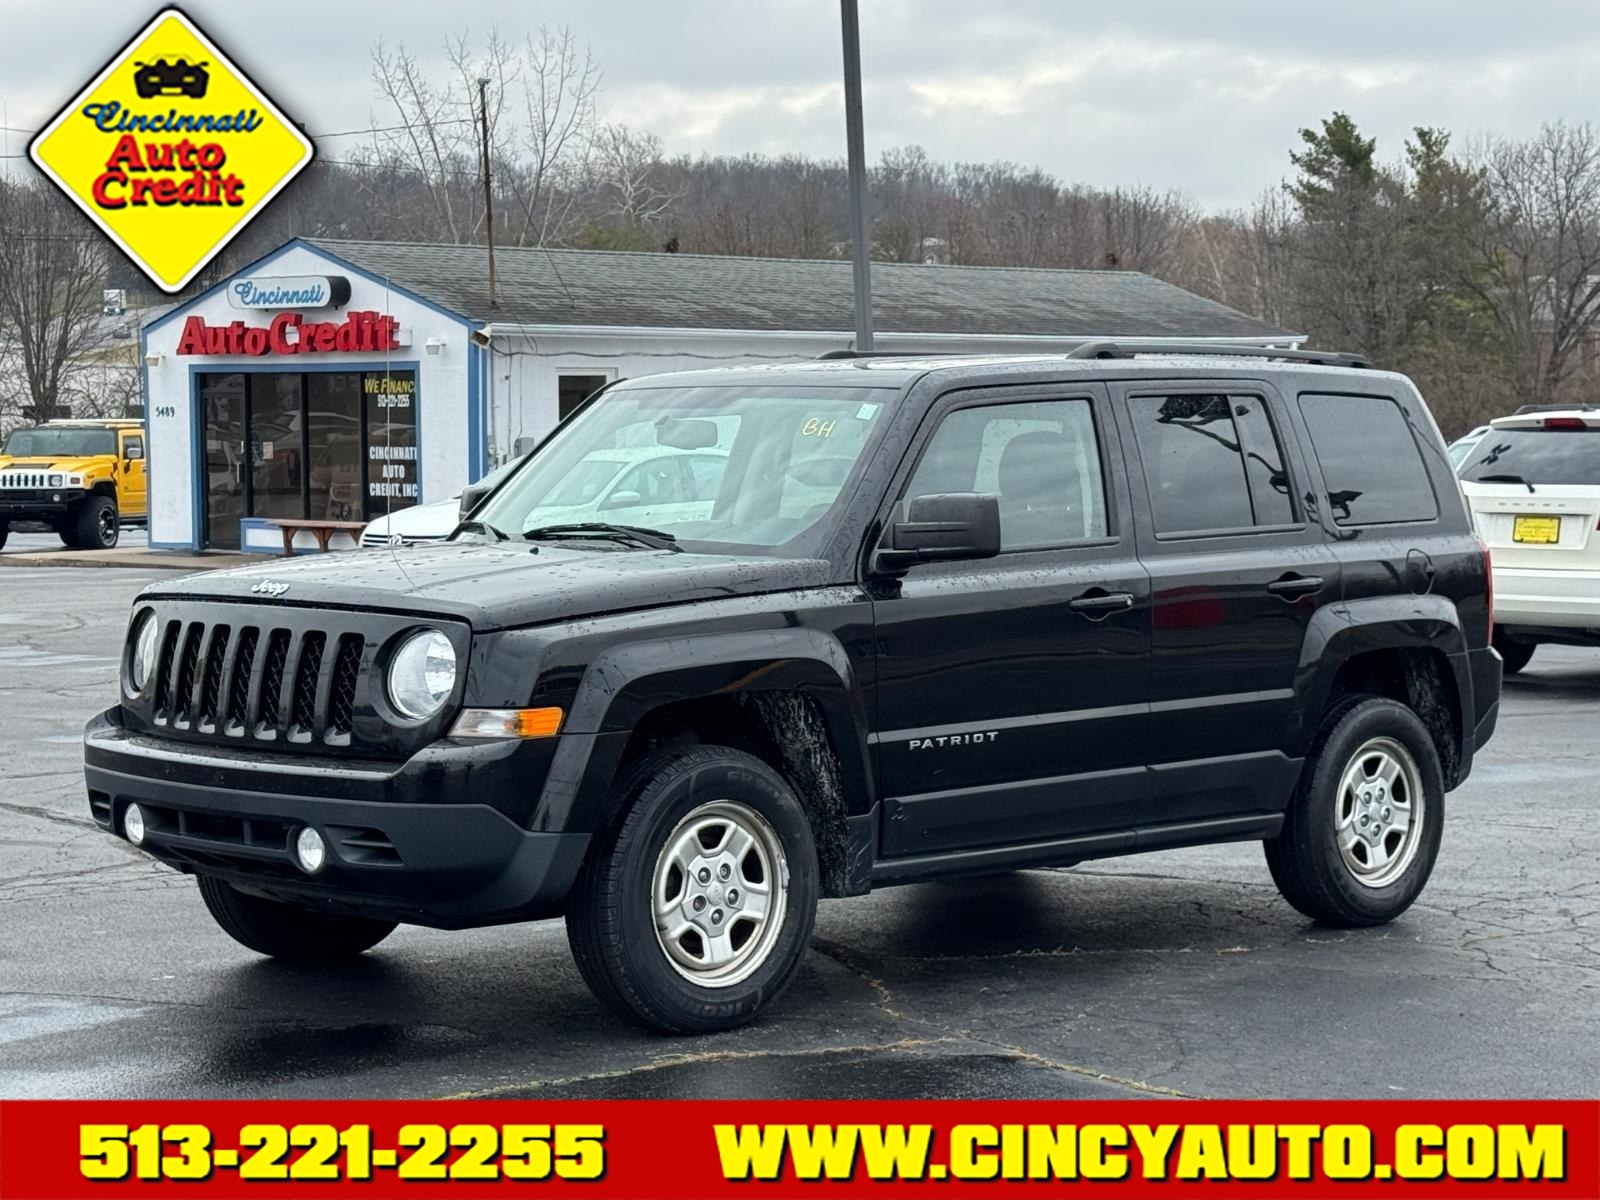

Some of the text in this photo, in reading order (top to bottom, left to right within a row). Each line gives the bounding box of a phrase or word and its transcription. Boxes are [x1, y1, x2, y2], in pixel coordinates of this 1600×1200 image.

[234, 282, 325, 305] Cincinnati
[381, 378, 416, 393] FINANC
[155, 406, 175, 418] 5489
[802, 417, 837, 438] BH
[369, 446, 417, 460] CINCINNATI
[382, 464, 405, 479] AUTO
[251, 579, 290, 597] Jeep
[908, 731, 1000, 750] PATRIOT
